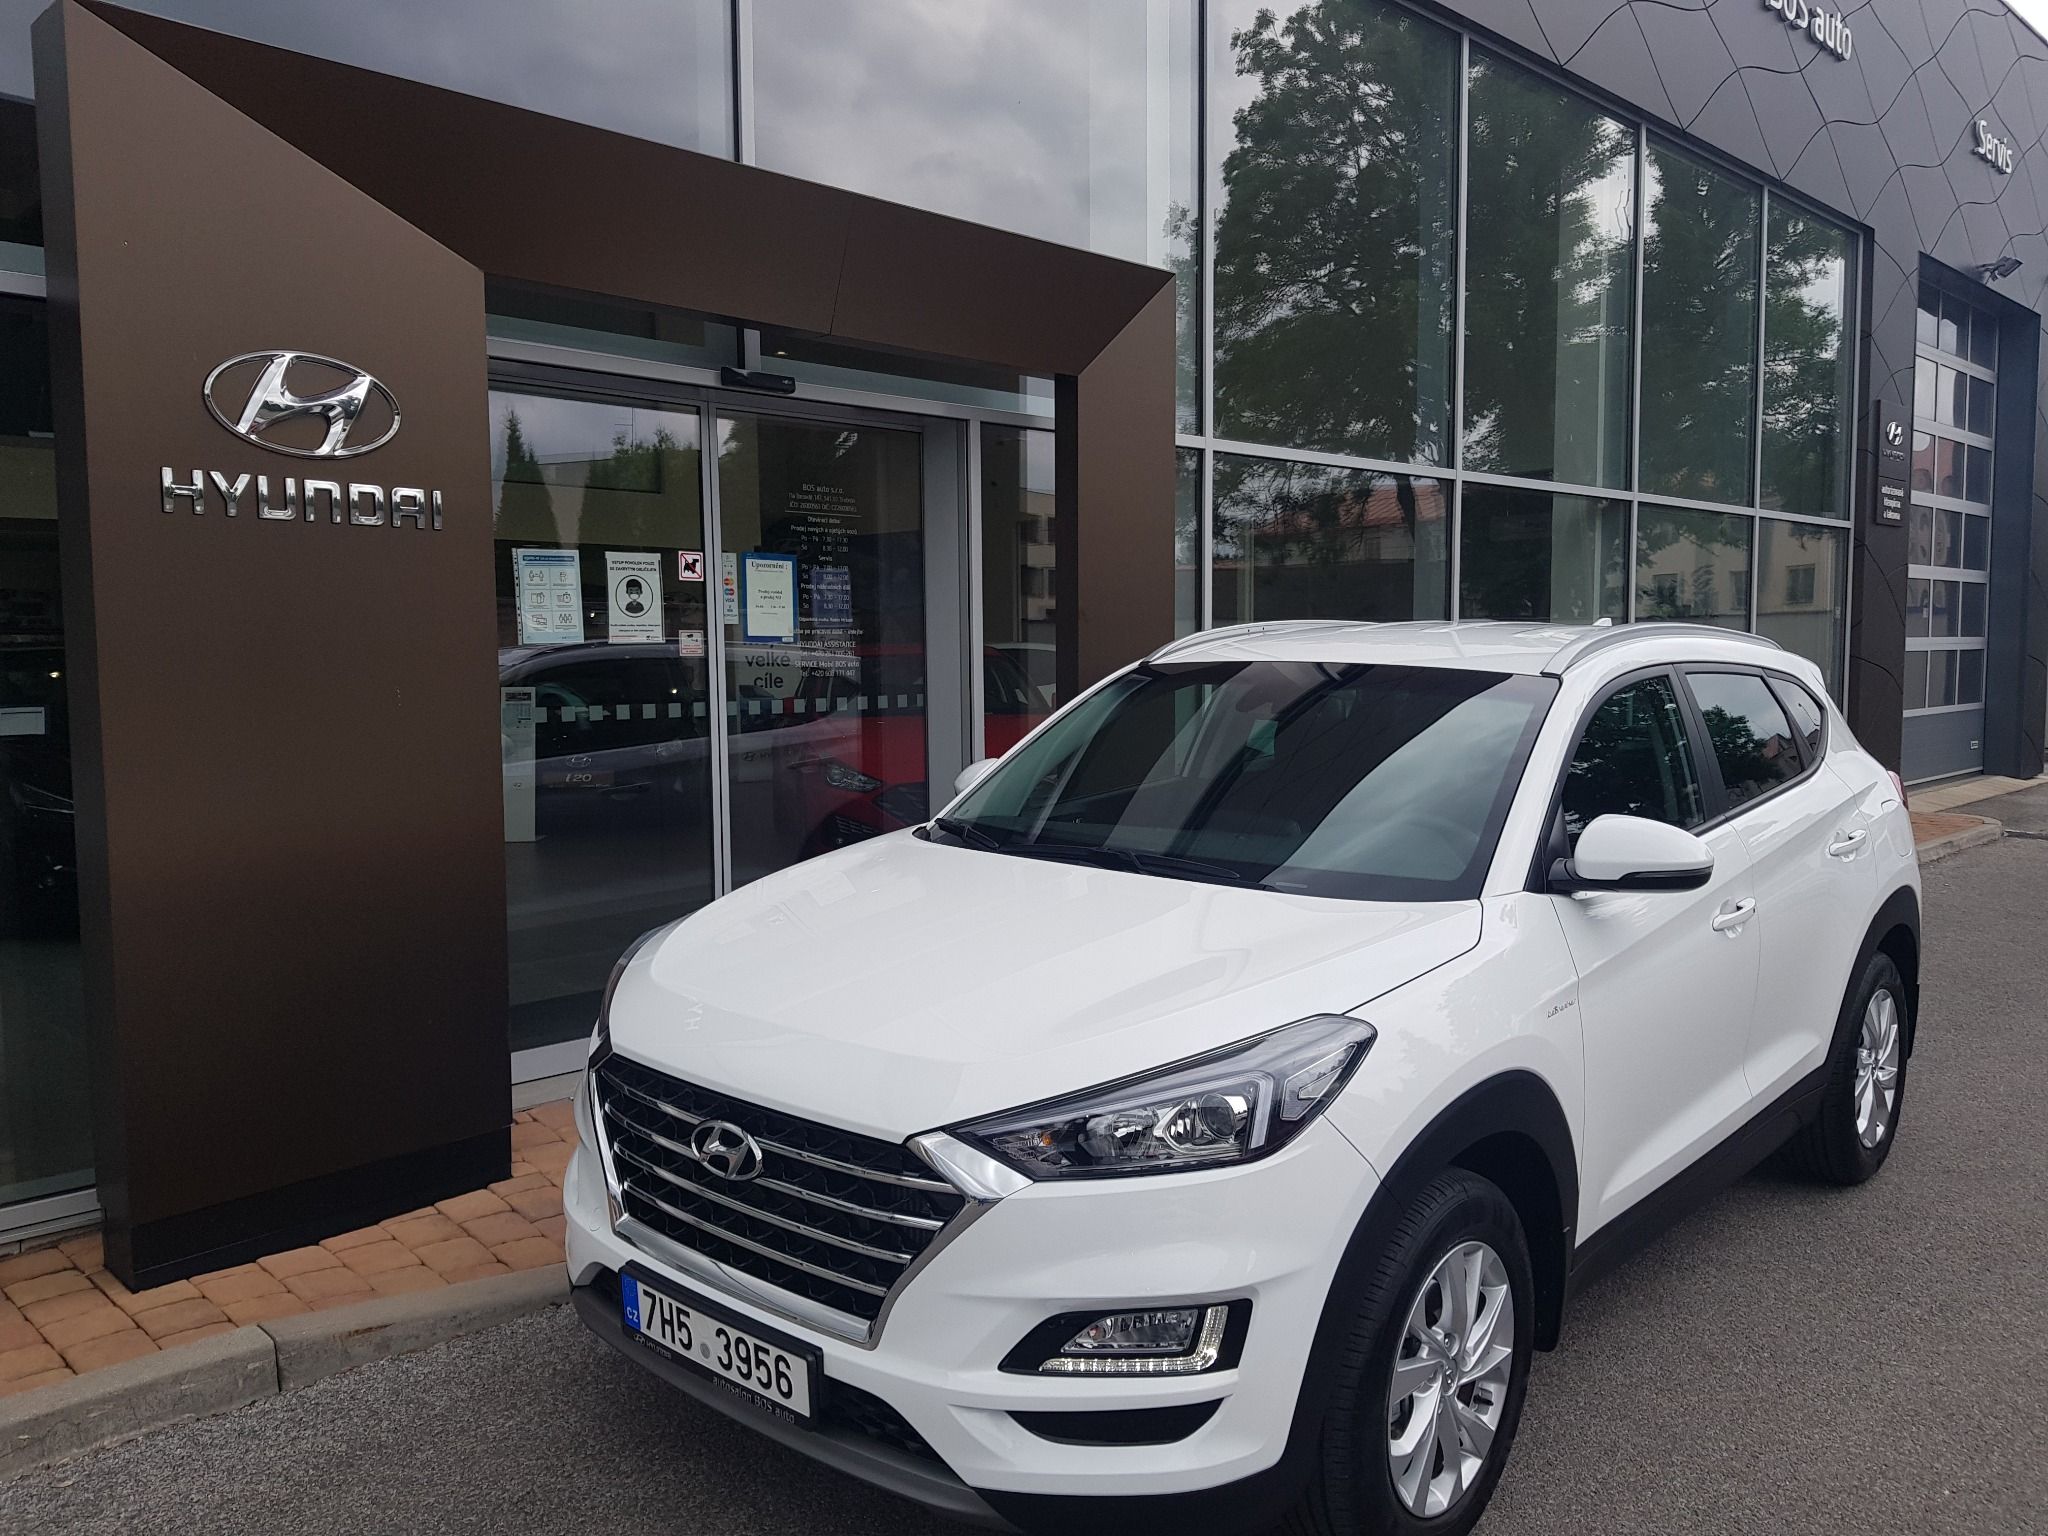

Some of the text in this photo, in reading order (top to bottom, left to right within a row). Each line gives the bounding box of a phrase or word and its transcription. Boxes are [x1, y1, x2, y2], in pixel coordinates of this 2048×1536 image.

[1811, 6, 1852, 61] auto
[1974, 118, 2013, 175] Servis
[161, 466, 443, 530] HYUNDAI
[803, 483, 815, 491] BOS
[745, 652, 790, 667] velké
[754, 672, 784, 689] cíle
[626, 1306, 639, 1323] CZ
[642, 1288, 793, 1400] 7H5 3956
[712, 1374, 795, 1425] autosalon BOS auto
